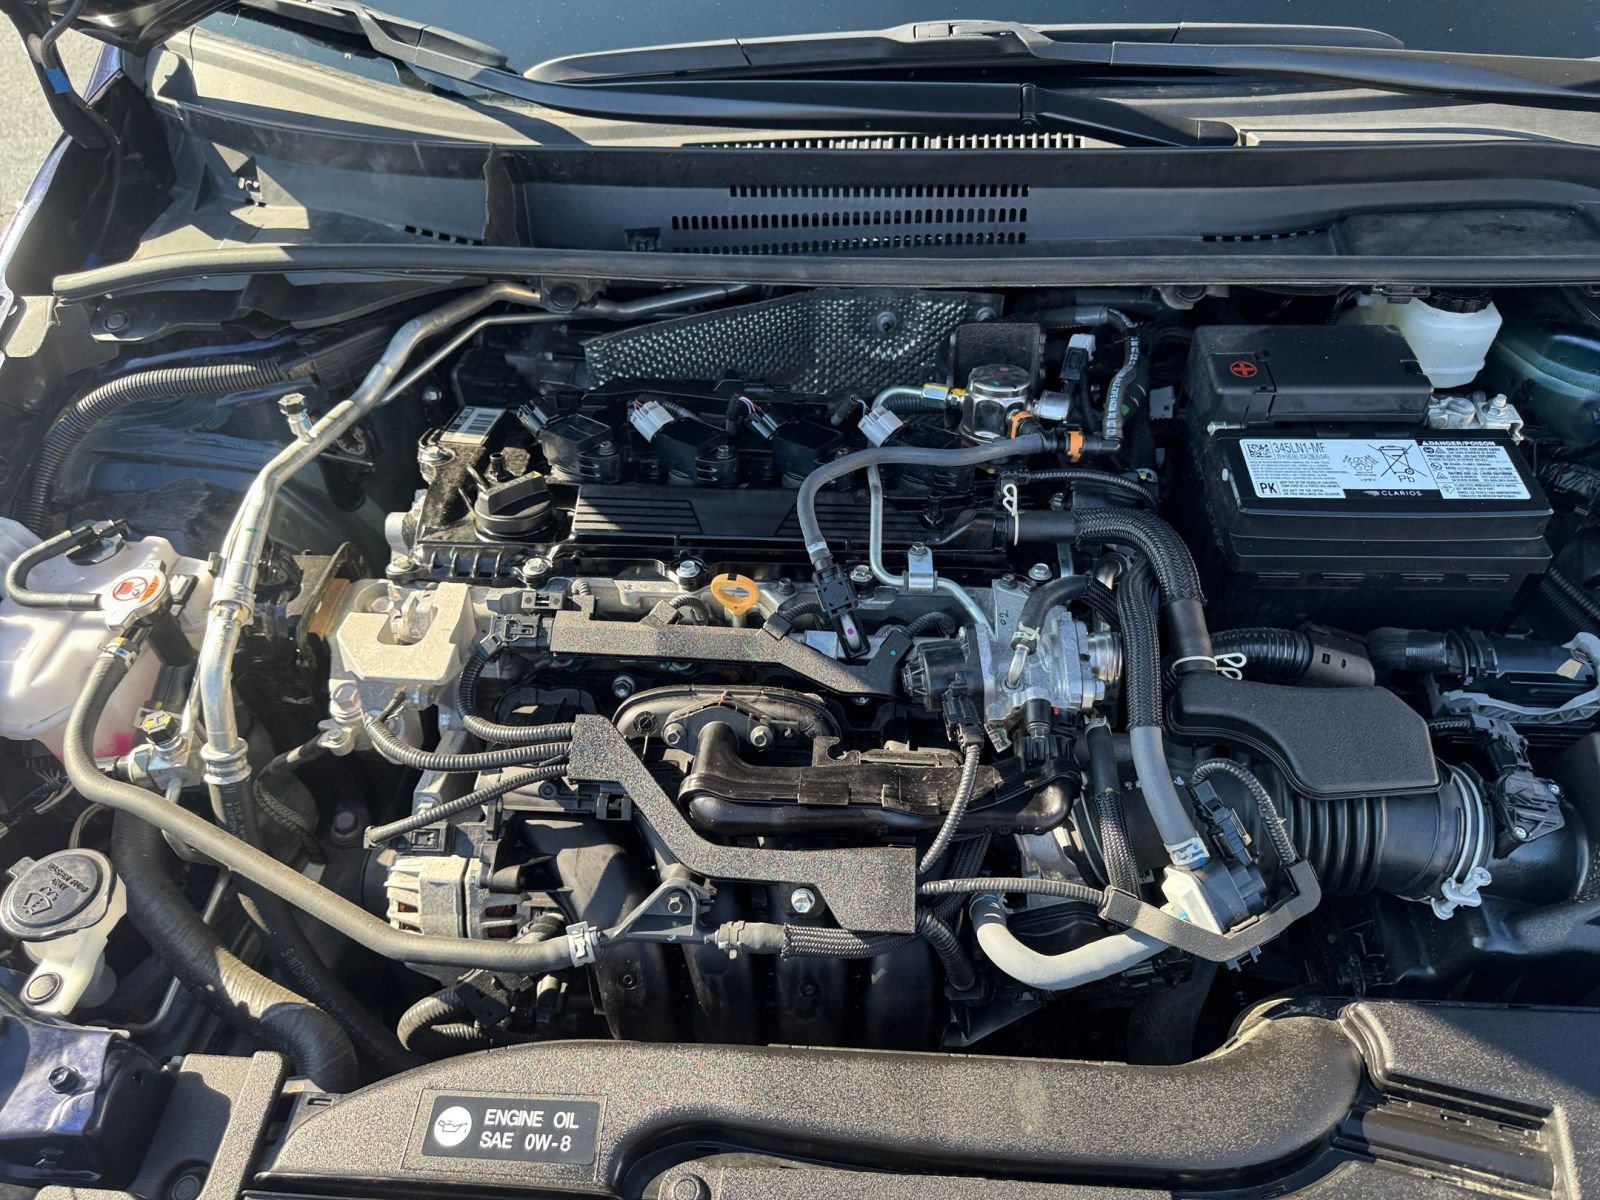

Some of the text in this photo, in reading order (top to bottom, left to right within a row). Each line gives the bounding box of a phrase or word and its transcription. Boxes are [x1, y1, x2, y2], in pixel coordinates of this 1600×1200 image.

[1272, 442, 1327, 454] 345LN1-MF
[1397, 475, 1416, 483] Pb
[1259, 482, 1278, 494] PK
[484, 1108, 579, 1129] ENGINE OIL
[479, 1131, 572, 1152] SAE 0W-8
